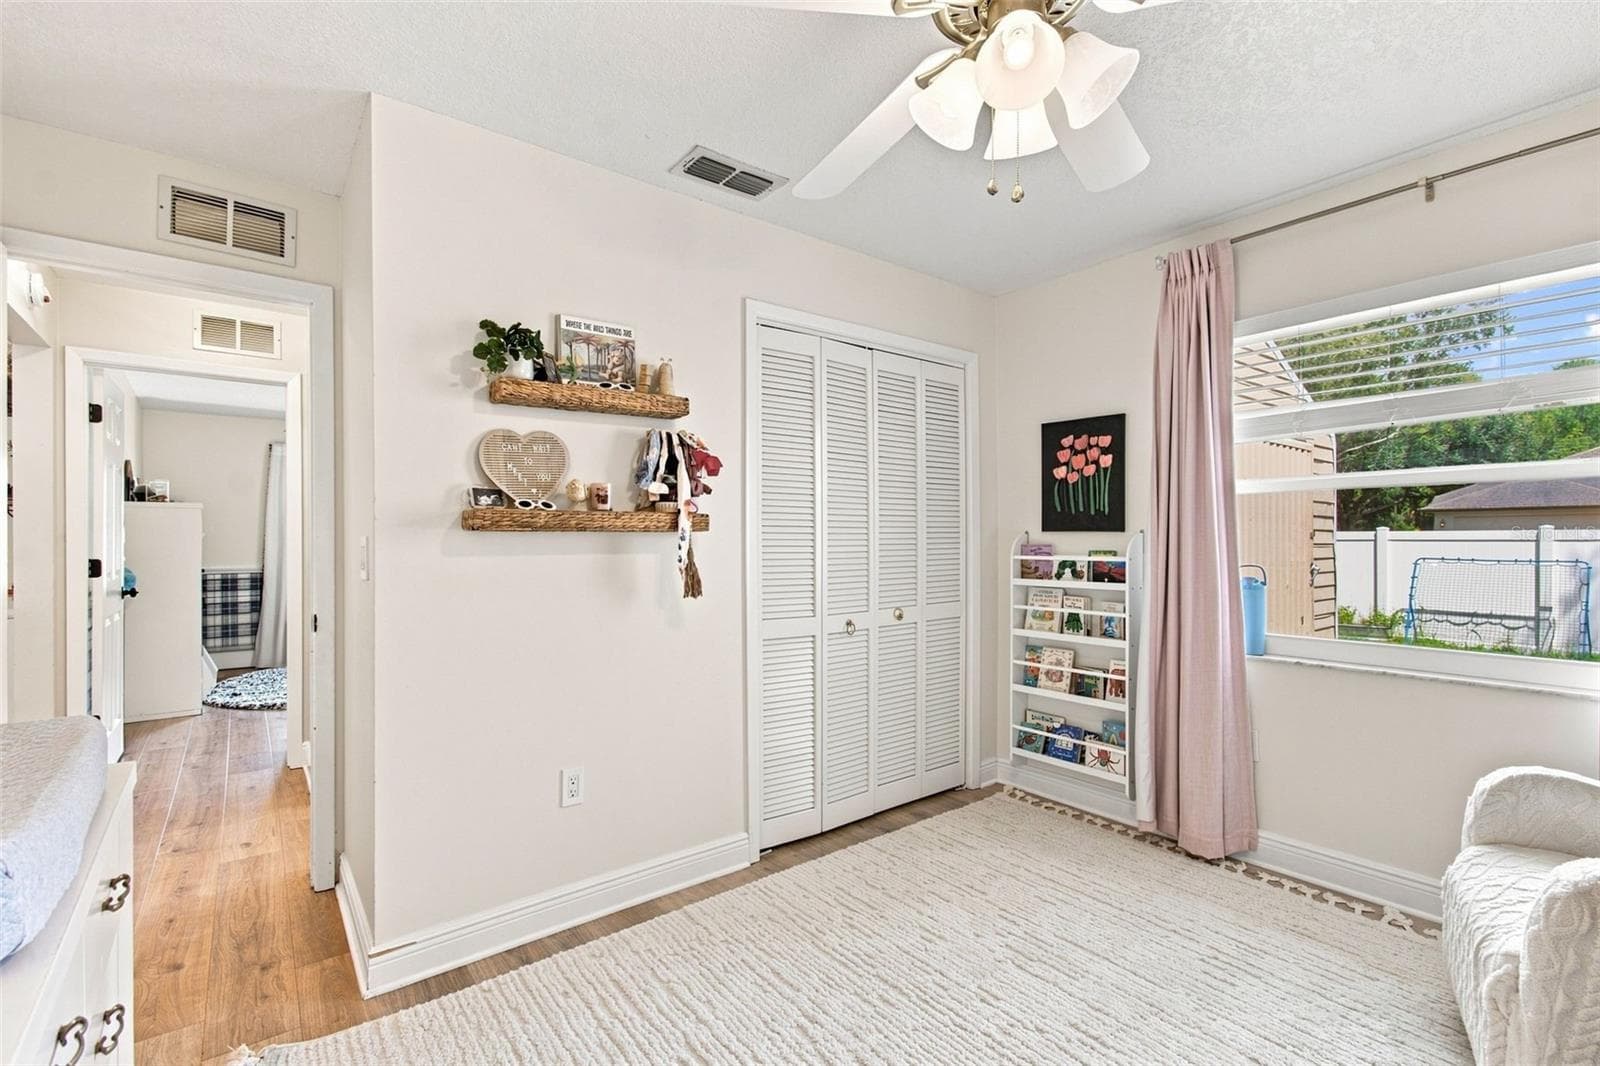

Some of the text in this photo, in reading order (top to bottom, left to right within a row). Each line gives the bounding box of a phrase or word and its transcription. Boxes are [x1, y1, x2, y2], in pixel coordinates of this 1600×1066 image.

[565, 320, 582, 330] WHERE
[583, 323, 592, 331] THE
[605, 326, 622, 336] THINGS
[623, 328, 633, 337] ARE
[532, 444, 550, 453] WAIT
[524, 456, 533, 465] TO
[536, 472, 551, 482] YOU
